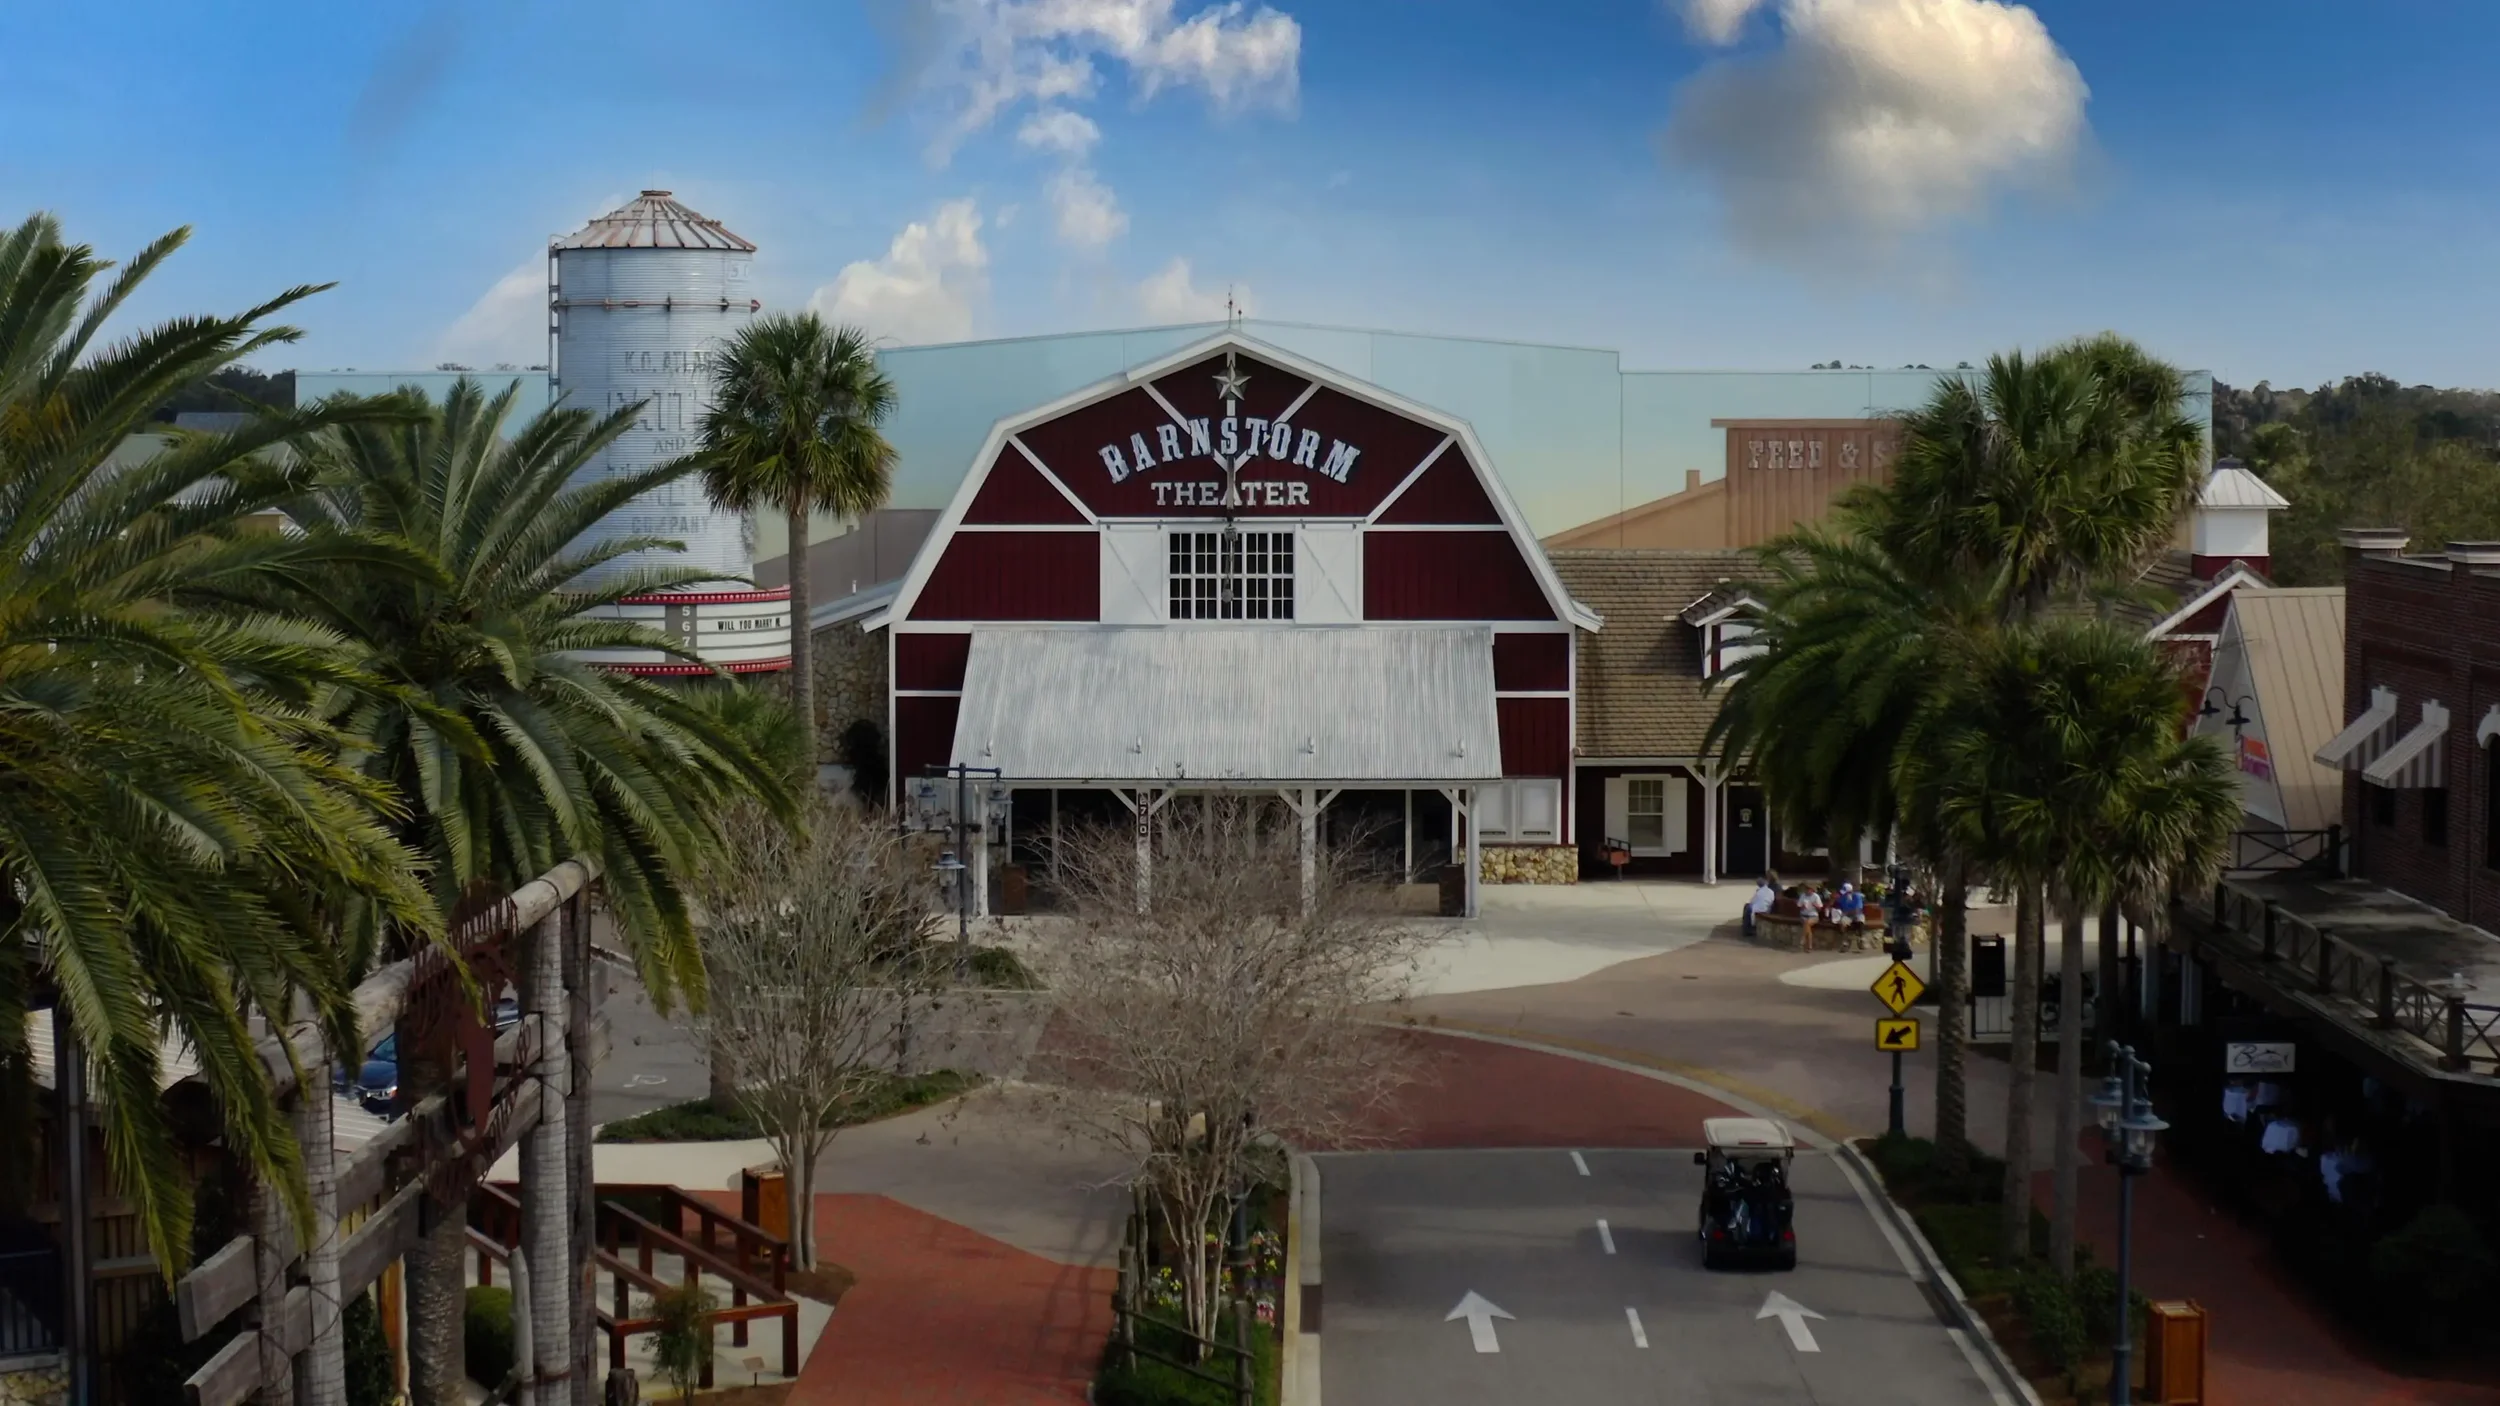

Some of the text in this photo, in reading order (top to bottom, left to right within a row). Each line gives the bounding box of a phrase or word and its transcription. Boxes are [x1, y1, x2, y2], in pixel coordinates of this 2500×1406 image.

[1098, 417, 1361, 484] BARNSTORM
[1748, 440, 1823, 469] FEED
[1151, 482, 1310, 506] THEATER
[682, 606, 691, 617] 5
[682, 621, 691, 632] 6
[717, 621, 735, 631] WILL
[739, 619, 752, 630] YOU
[682, 636, 691, 647] 7
